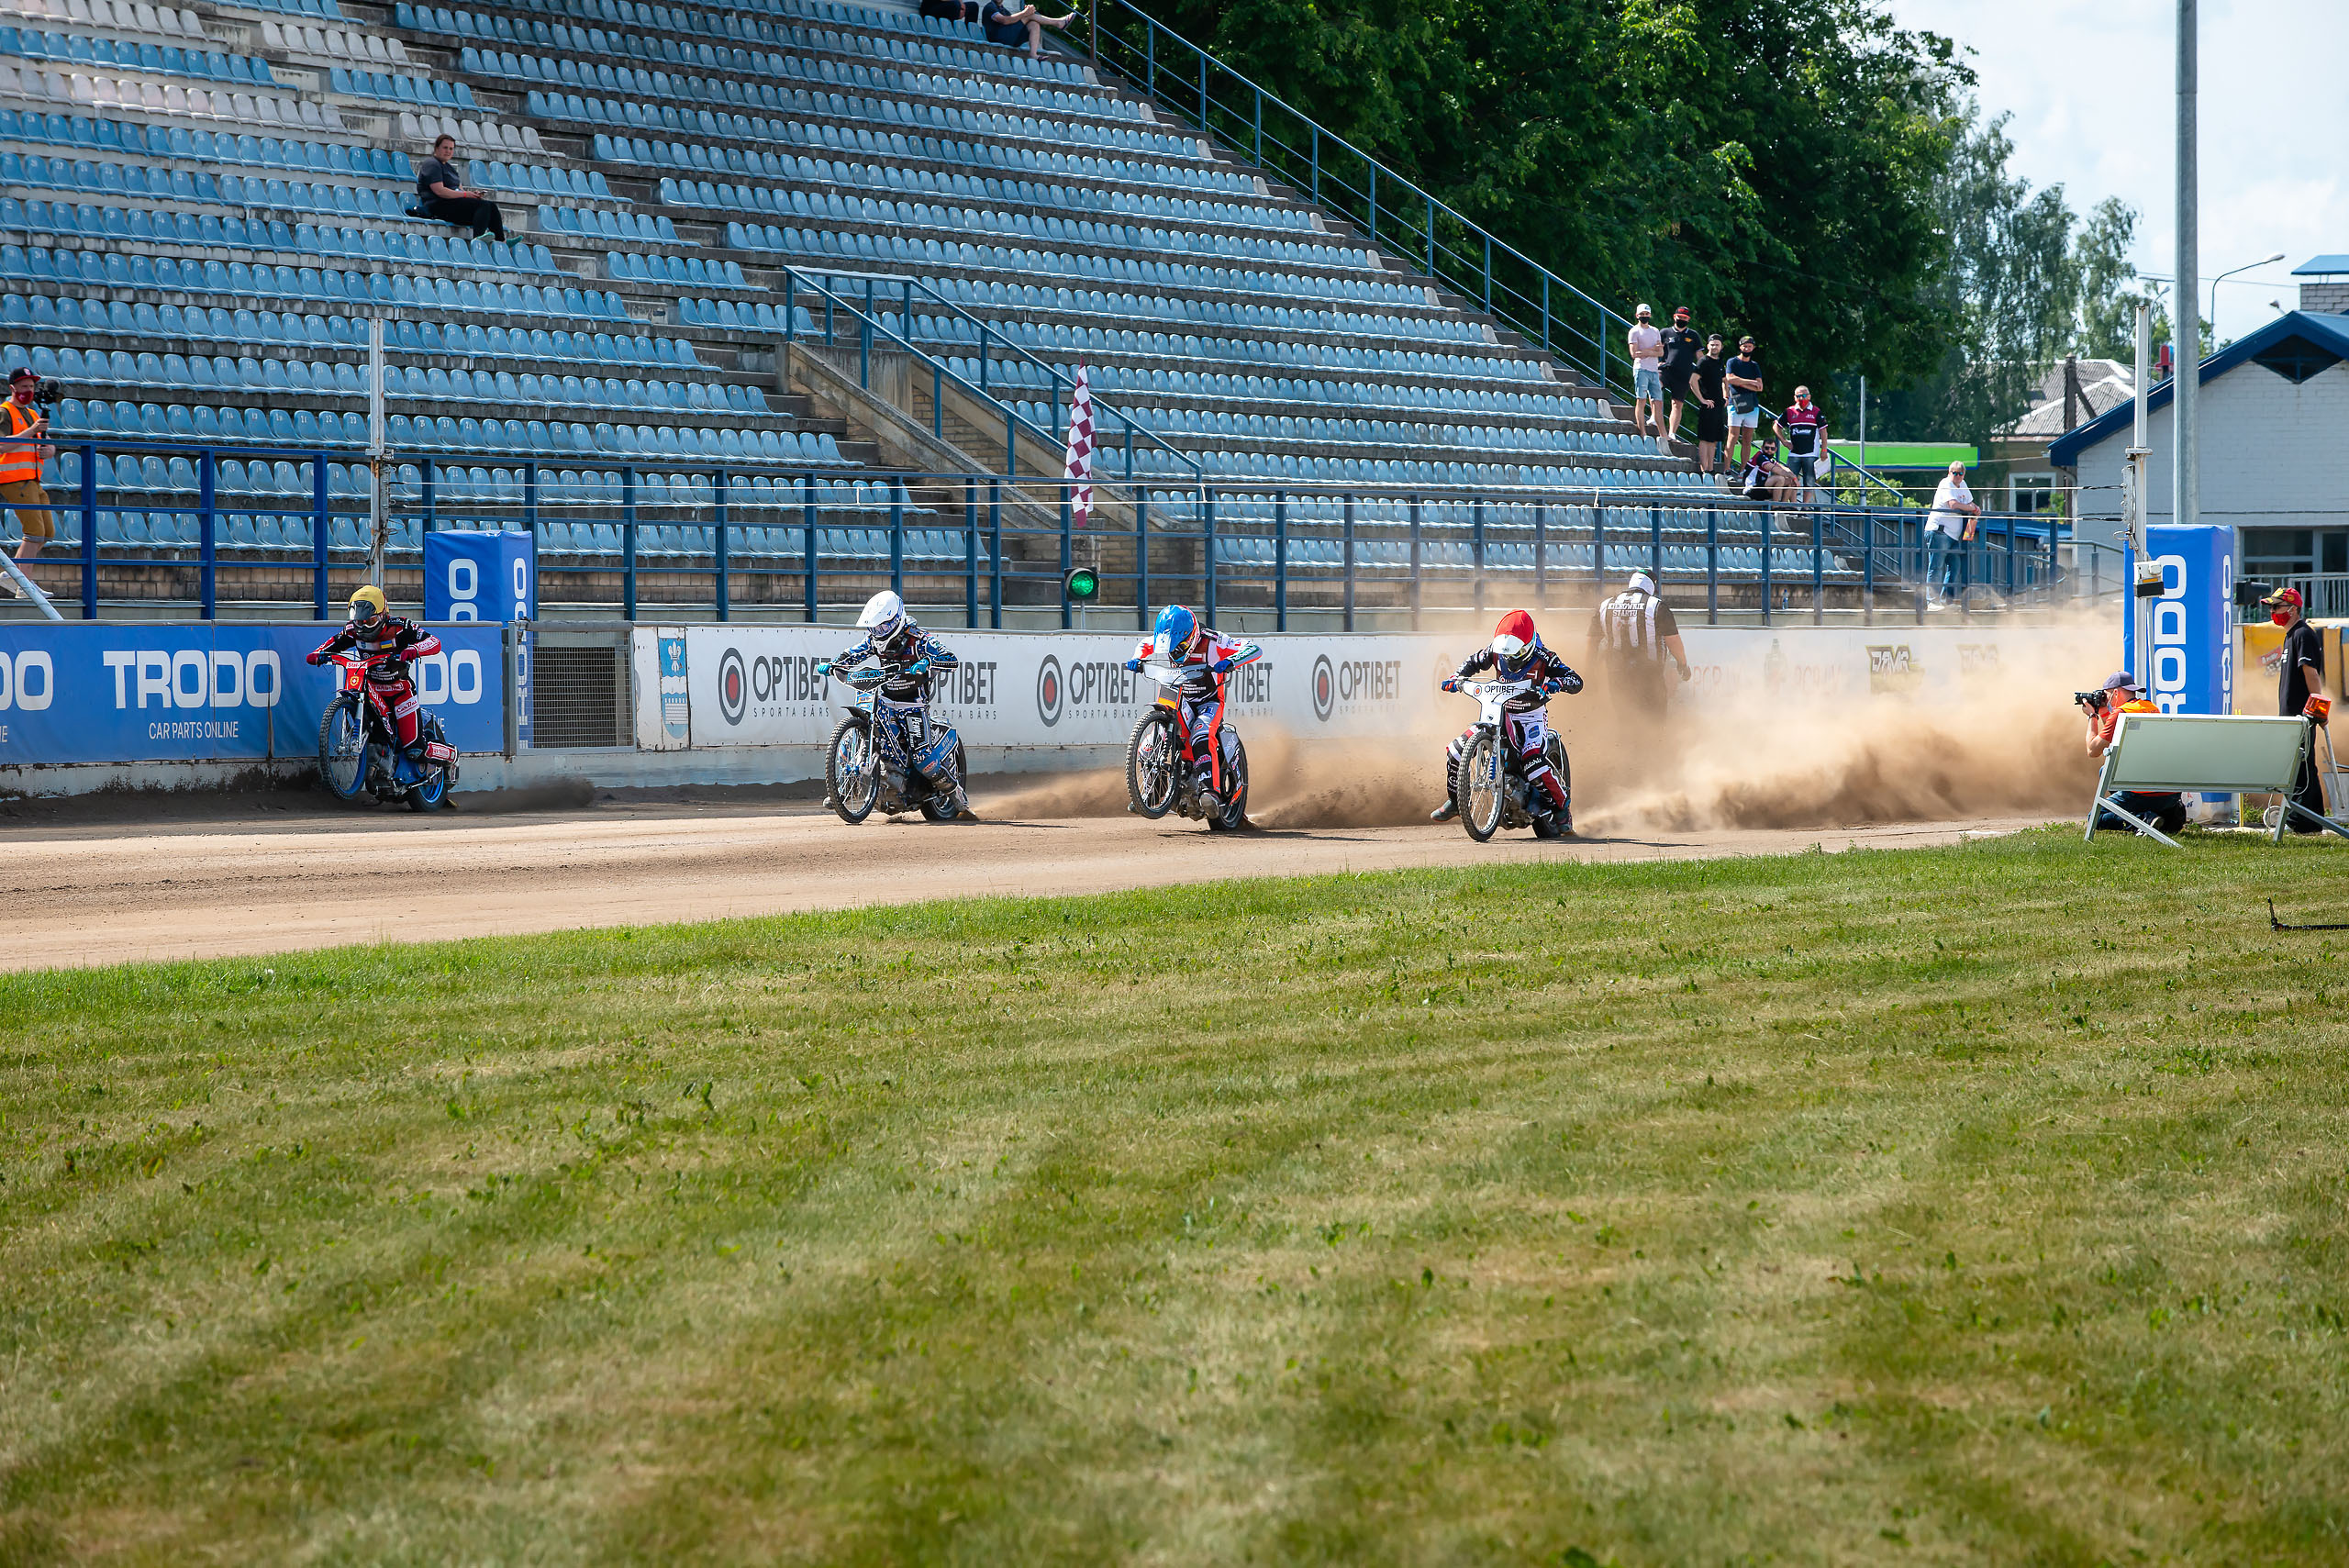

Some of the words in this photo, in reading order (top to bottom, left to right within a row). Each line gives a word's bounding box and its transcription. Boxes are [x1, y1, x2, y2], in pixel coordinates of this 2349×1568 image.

[103, 650, 282, 709] TRODO
[752, 655, 831, 702] OPTIBET
[1224, 662, 1273, 703] PTIBET
[1340, 661, 1401, 701] OPTIBET
[1484, 685, 1516, 694] OPTIBET
[753, 707, 796, 717] SPORTA
[1068, 709, 1108, 719] SPORTA
[149, 722, 171, 740] CAR
[172, 720, 203, 740] PARTS
[205, 720, 239, 740] ONLINE
